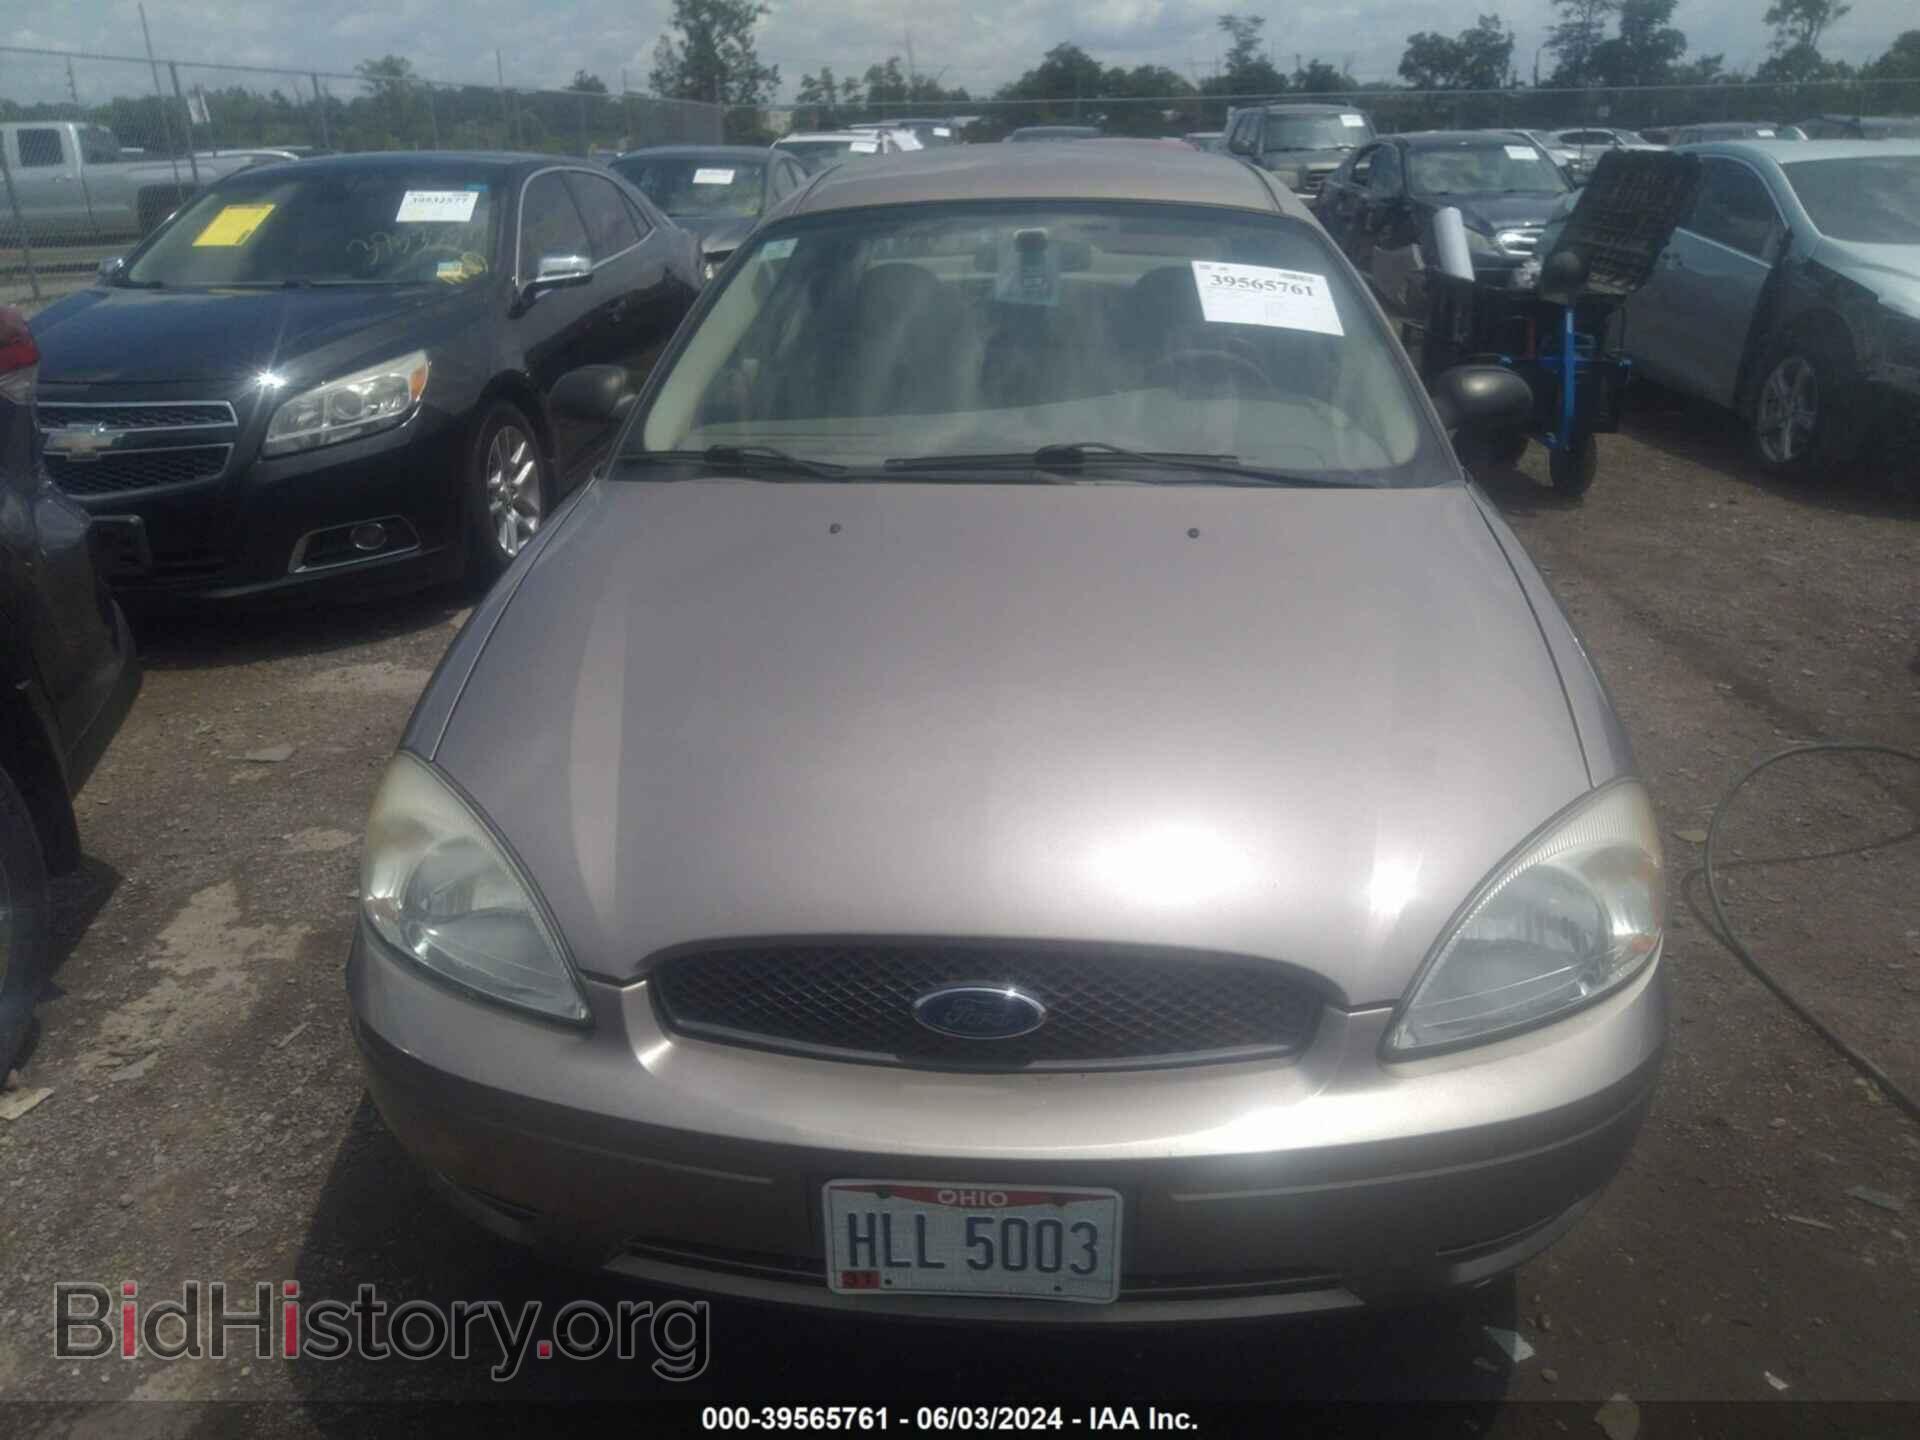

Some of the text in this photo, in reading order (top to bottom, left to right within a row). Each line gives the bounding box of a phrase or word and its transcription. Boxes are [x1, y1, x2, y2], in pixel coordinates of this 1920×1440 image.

[1210, 274, 1314, 297] 39565761
[937, 1189, 1008, 1208] OHIO
[848, 1212, 1099, 1275] HLL 5003
